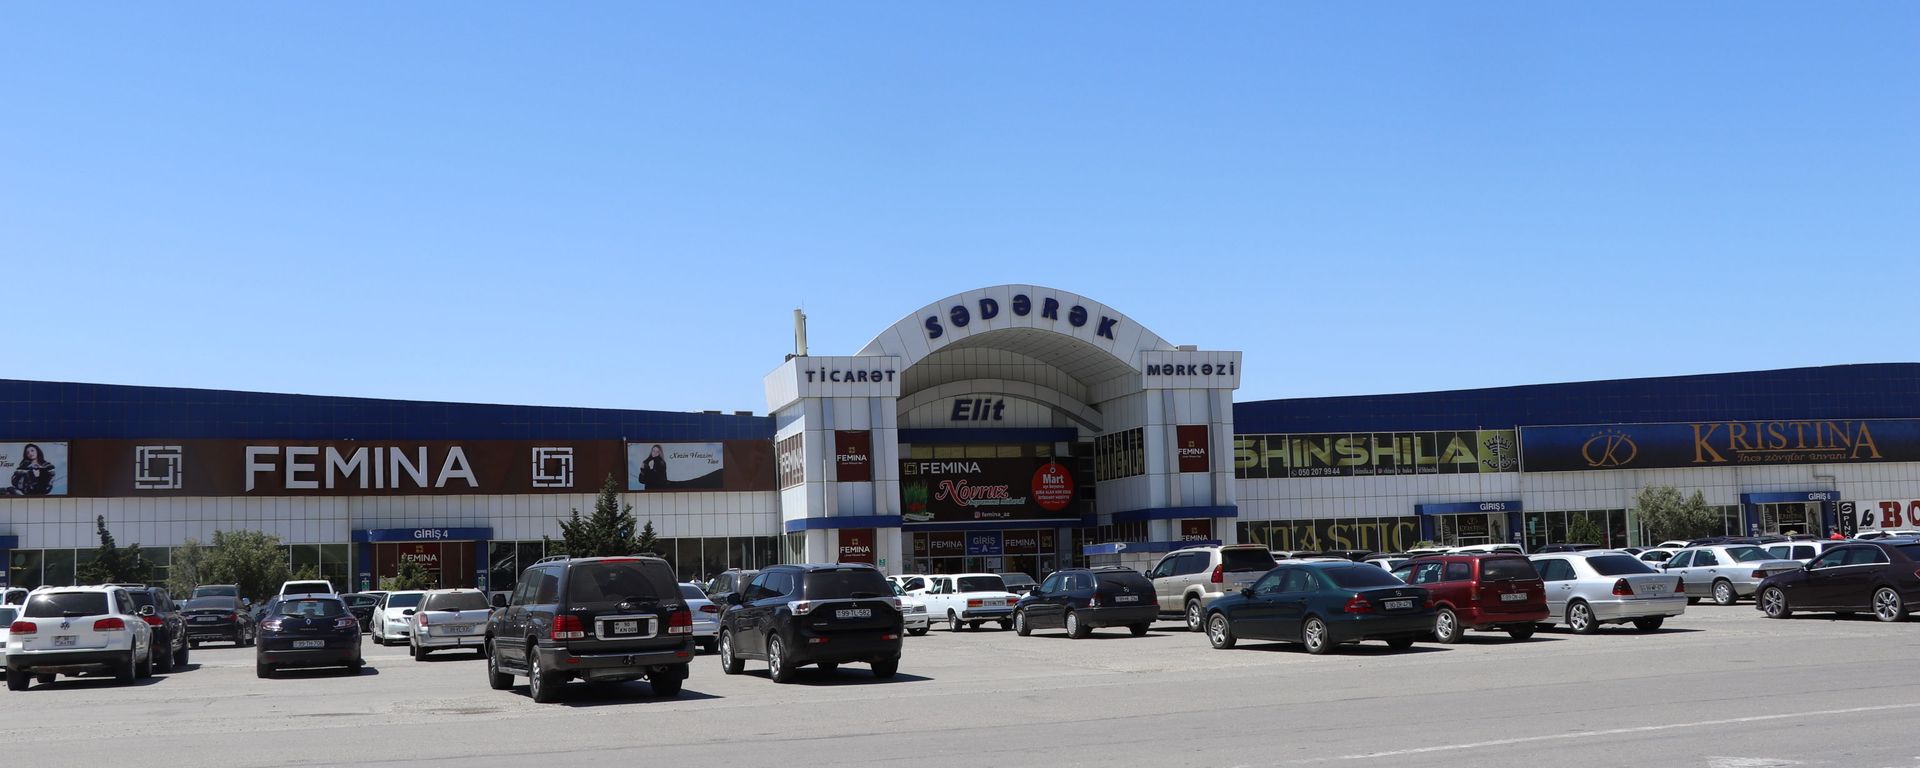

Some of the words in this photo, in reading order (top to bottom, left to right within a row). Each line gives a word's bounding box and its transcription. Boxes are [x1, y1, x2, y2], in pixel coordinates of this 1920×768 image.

[925, 294, 1117, 340] SƏDƏRƏK
[805, 367, 895, 382] TİCARƏT
[1147, 362, 1234, 376] MƏRKƏZİ
[951, 399, 1005, 421] Elit
[1689, 420, 1882, 463] KRISTINA
[1234, 436, 1478, 468] SHINSHILA
[246, 446, 479, 491] FEMINA
[920, 462, 981, 474] FEMINA
[1298, 468, 1310, 476] 050
[1323, 467, 1332, 475] 99
[1332, 467, 1340, 475] 44
[1043, 473, 1064, 484] Mart
[935, 479, 1009, 507] Novruz
[414, 528, 441, 540] GİRİŞ
[443, 530, 448, 538] 4
[931, 541, 962, 549] FEMINA
[972, 536, 996, 546] GİRİŞ
[1005, 539, 1036, 547] FEMINA
[840, 546, 870, 554] FEMINA
[981, 545, 988, 553] A
